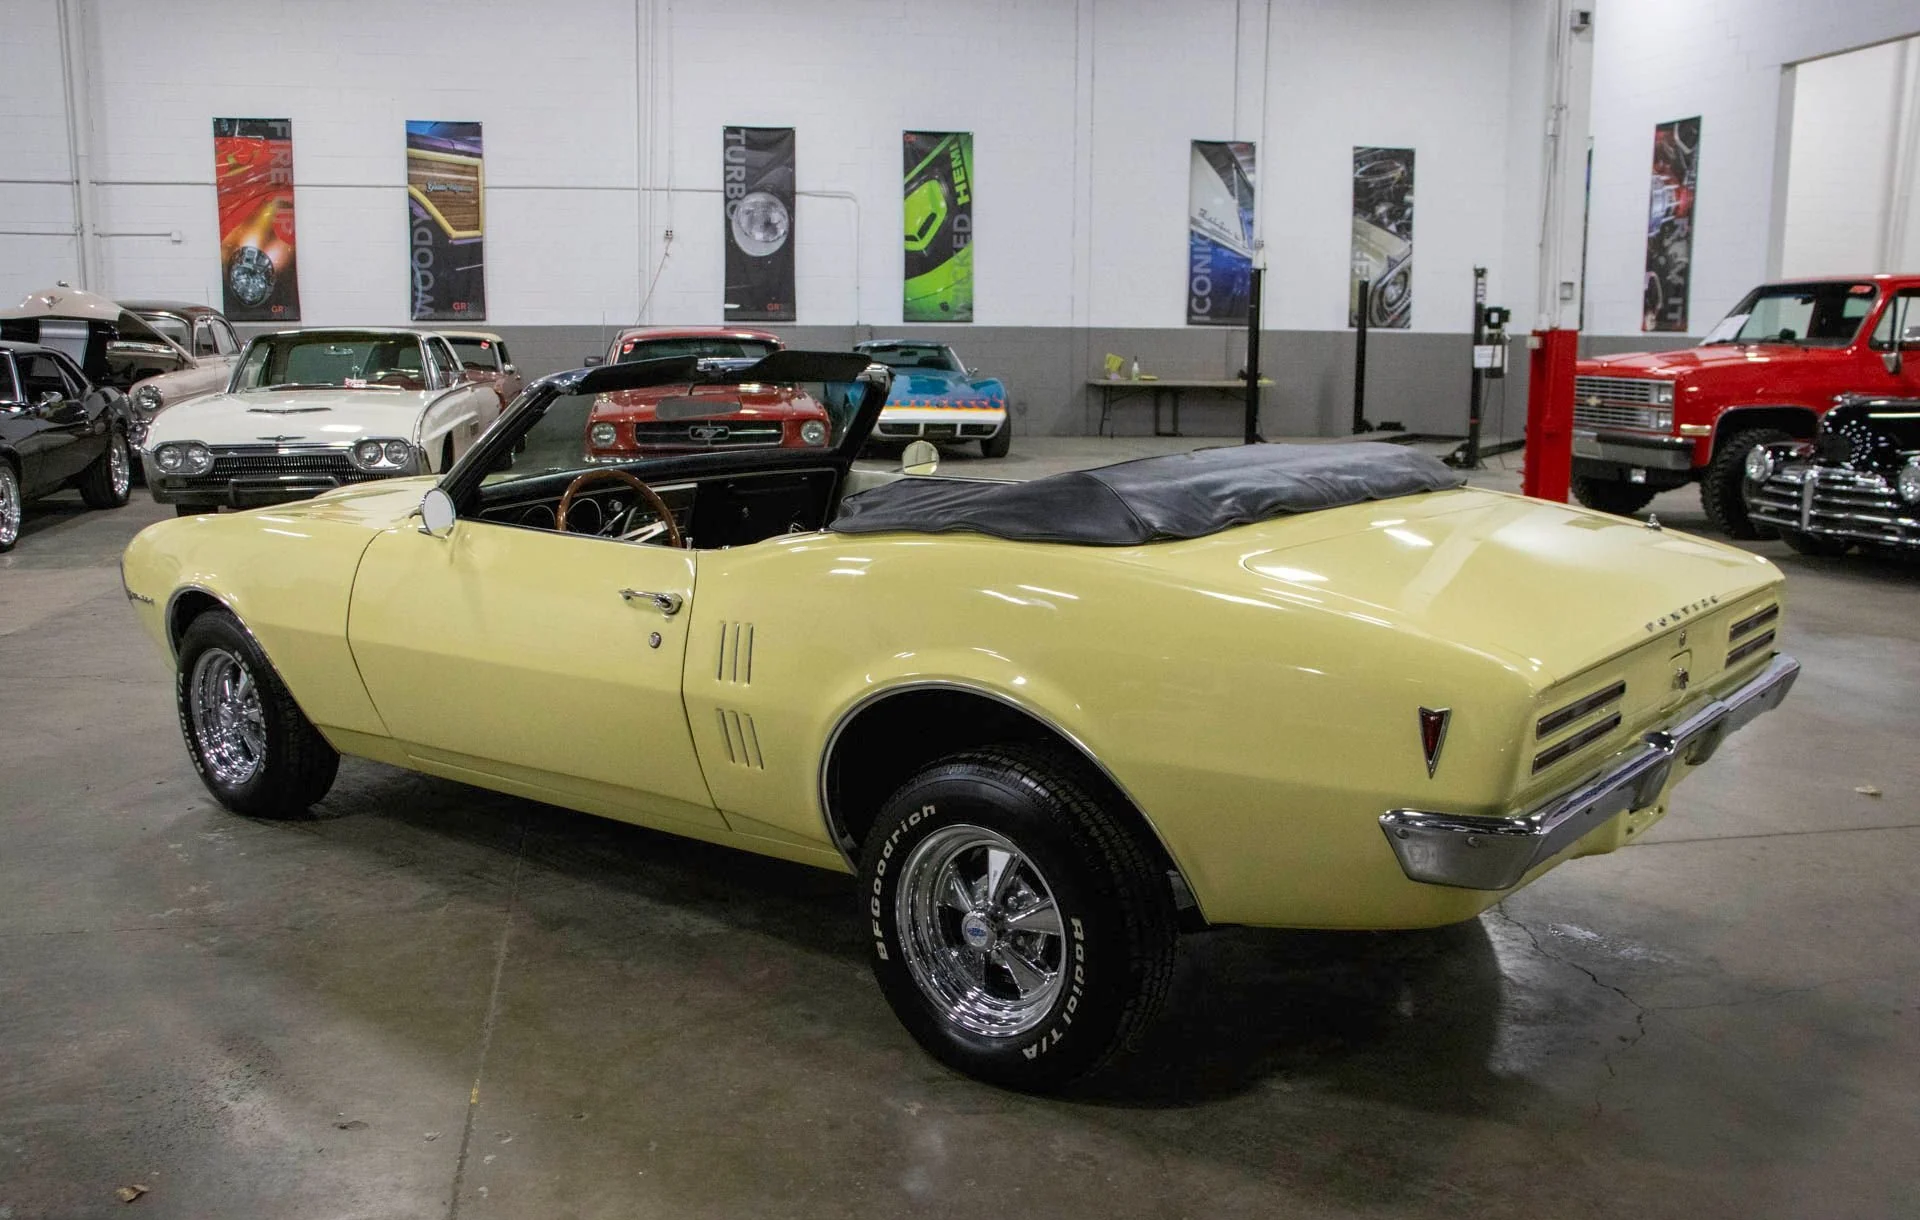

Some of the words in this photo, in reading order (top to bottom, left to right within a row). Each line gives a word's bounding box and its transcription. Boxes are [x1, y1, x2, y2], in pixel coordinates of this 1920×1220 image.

[725, 129, 746, 221] TURBO
[949, 142, 970, 206] HEMI
[412, 212, 435, 318] WOODY
[1645, 595, 1718, 632] PONTIAC
[871, 804, 936, 960] BFGoodrich
[1061, 917, 1085, 1025] Radial
[1022, 1027, 1064, 1060] T/A
